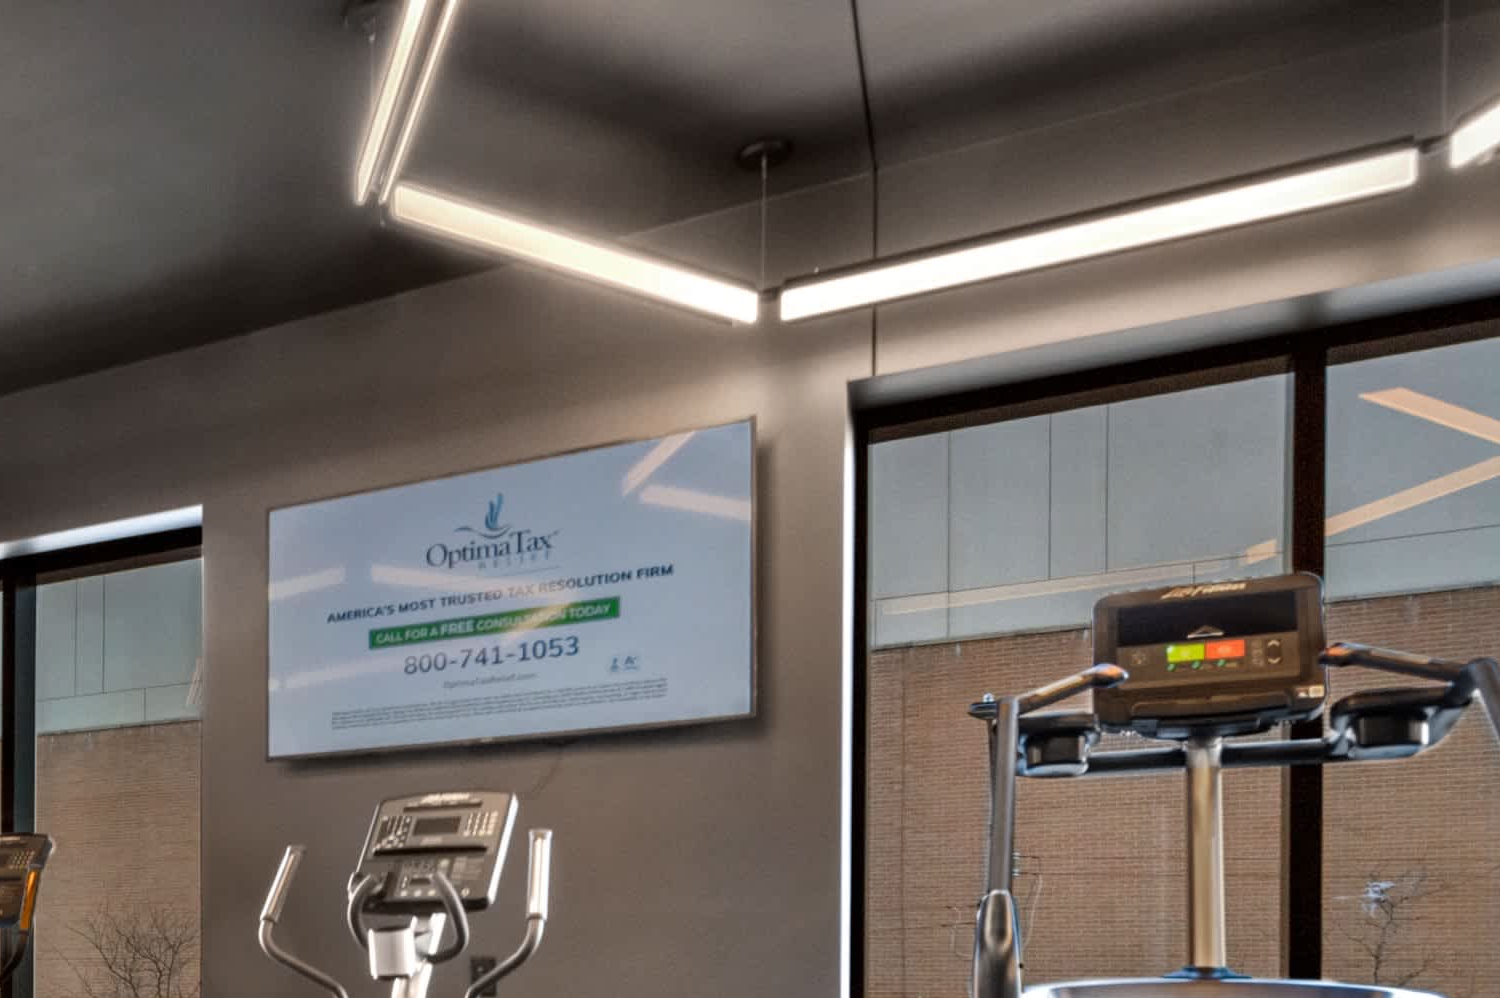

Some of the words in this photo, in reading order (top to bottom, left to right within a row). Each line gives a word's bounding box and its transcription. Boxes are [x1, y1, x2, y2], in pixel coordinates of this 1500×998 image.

[425, 540, 510, 569] Optima
[508, 529, 553, 553] Tax
[327, 604, 395, 624] AMERICA'S
[398, 597, 437, 614] MOST
[440, 589, 503, 608] TRUSTED
[507, 585, 534, 599] TAX
[538, 570, 633, 594] RESOLUTION
[636, 563, 674, 580] FIRM
[375, 631, 404, 645] CALL
[405, 627, 428, 640] FOR
[429, 626, 439, 637] A
[440, 619, 475, 636] FREE
[476, 606, 567, 632] CONSULON
[569, 603, 612, 619] TODAY
[403, 635, 580, 675] 800-741-1053
